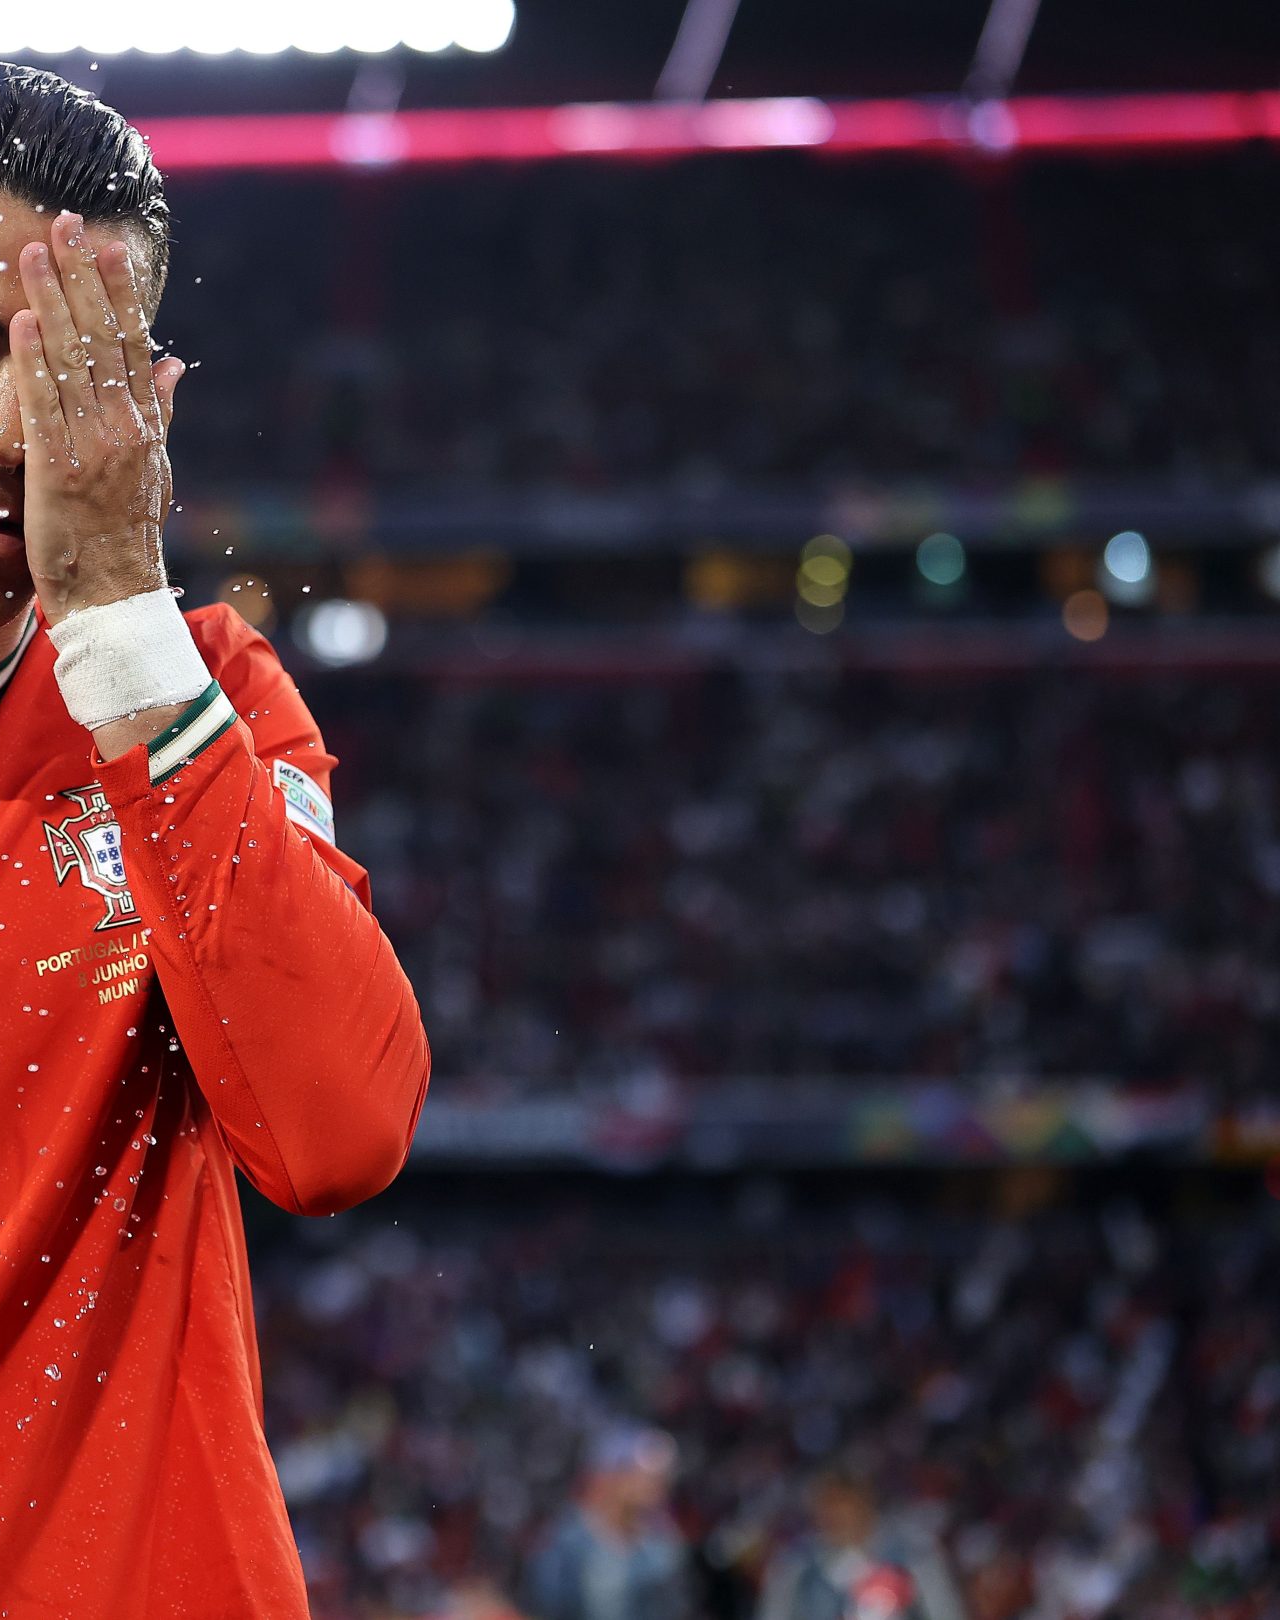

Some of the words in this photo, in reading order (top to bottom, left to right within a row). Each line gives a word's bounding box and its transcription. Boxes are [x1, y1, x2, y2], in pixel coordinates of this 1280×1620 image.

[279, 766, 304, 784] UEFA
[35, 937, 130, 977] PORTUGAL
[92, 953, 148, 985] JUNHO
